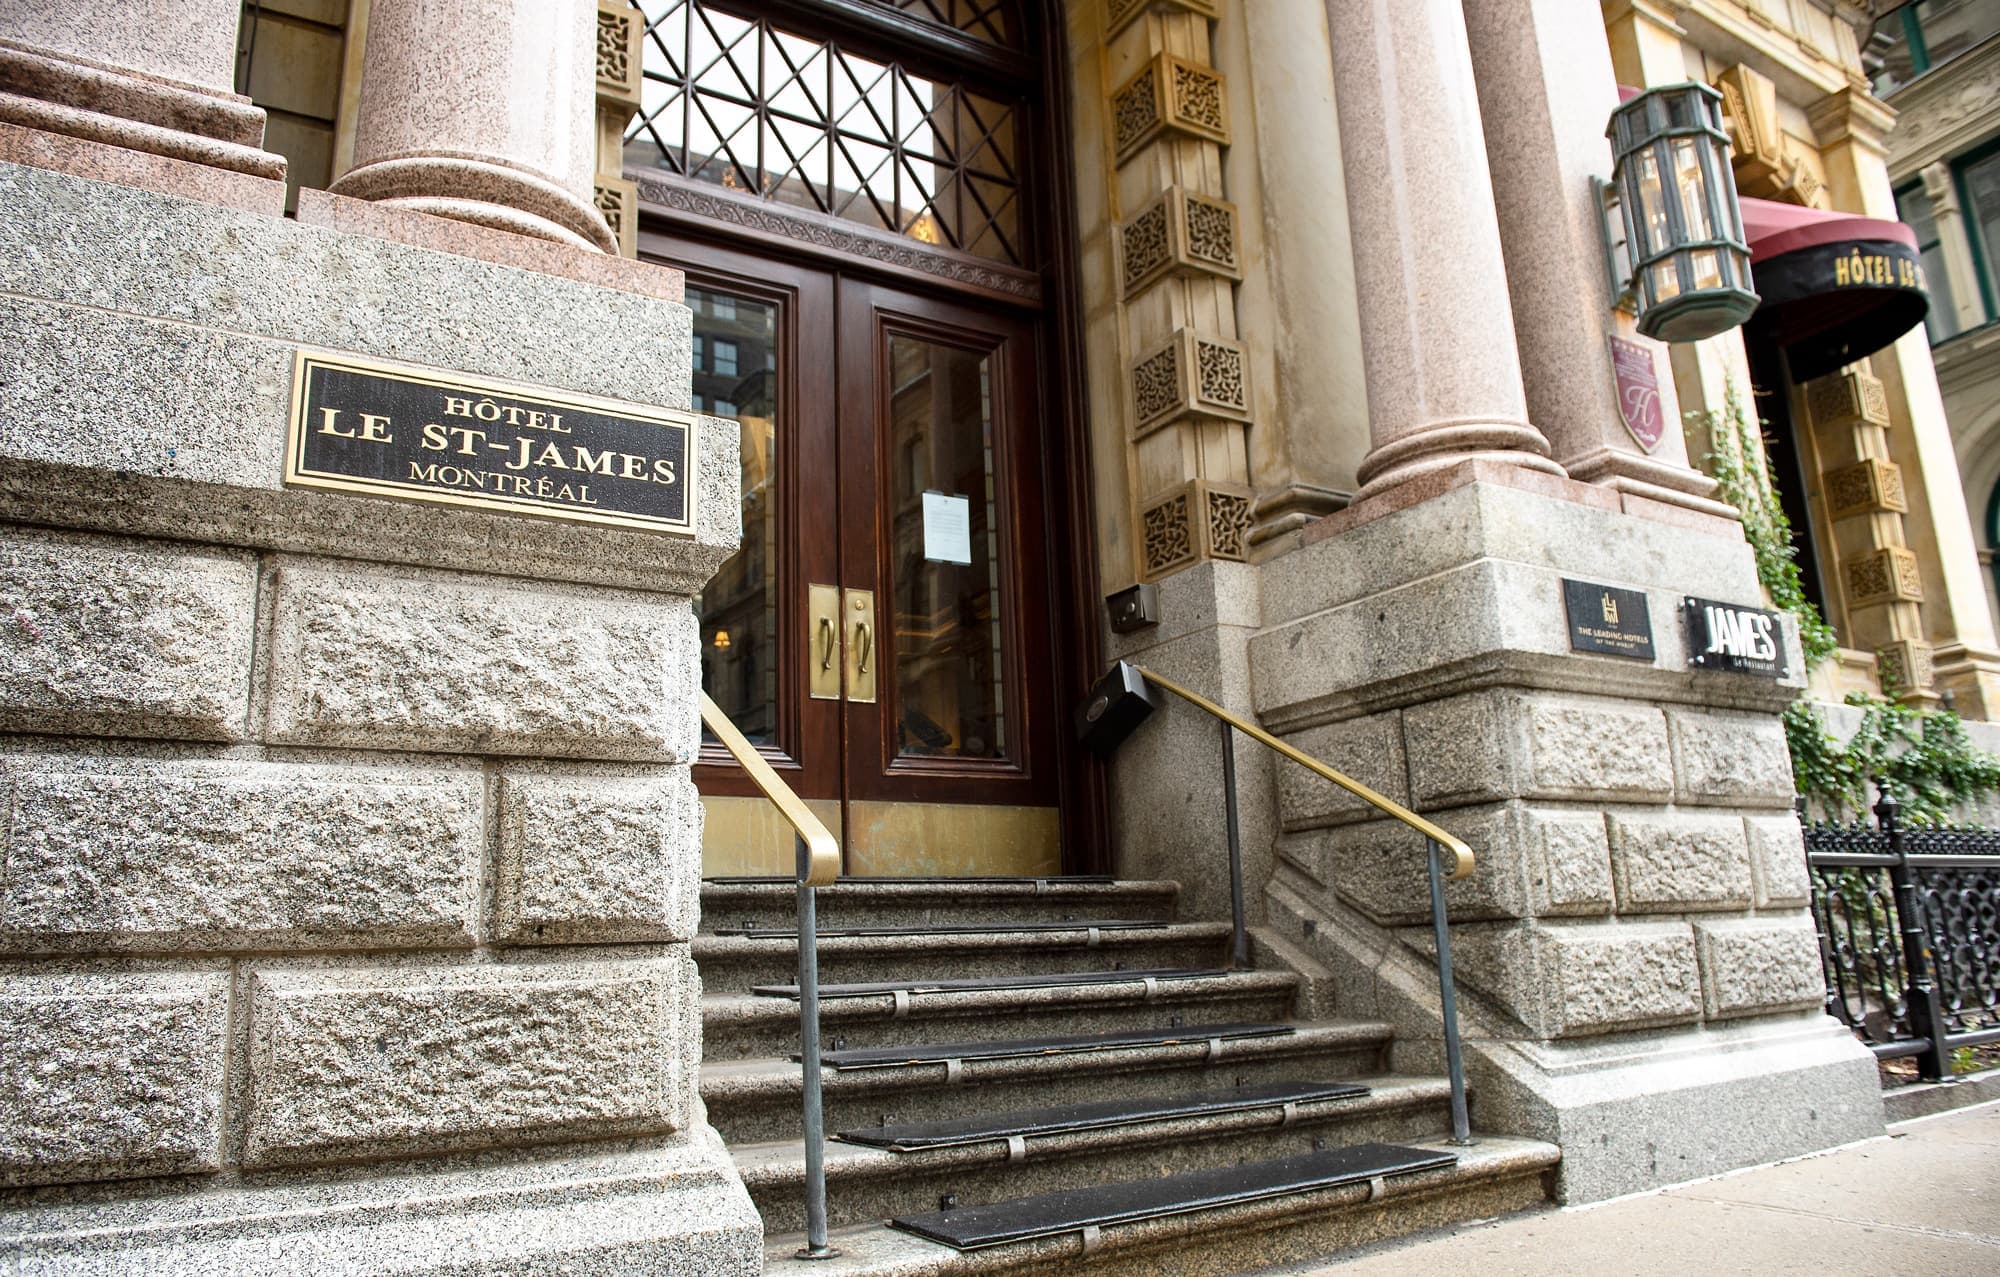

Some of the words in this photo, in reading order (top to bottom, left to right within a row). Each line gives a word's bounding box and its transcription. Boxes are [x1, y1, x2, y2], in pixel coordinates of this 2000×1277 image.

[1835, 246, 1895, 287] HÔTEL
[1898, 257, 1915, 287] LE
[444, 395, 571, 433] HÔTEL
[318, 407, 393, 443] LE
[421, 423, 677, 485] ST-JAMES
[407, 461, 598, 504] MONTRÉAL
[1578, 626, 1592, 636] THE
[1593, 629, 1622, 640] LEADING
[1623, 633, 1649, 644] HOTELS
[1705, 606, 1777, 661] JAMES
